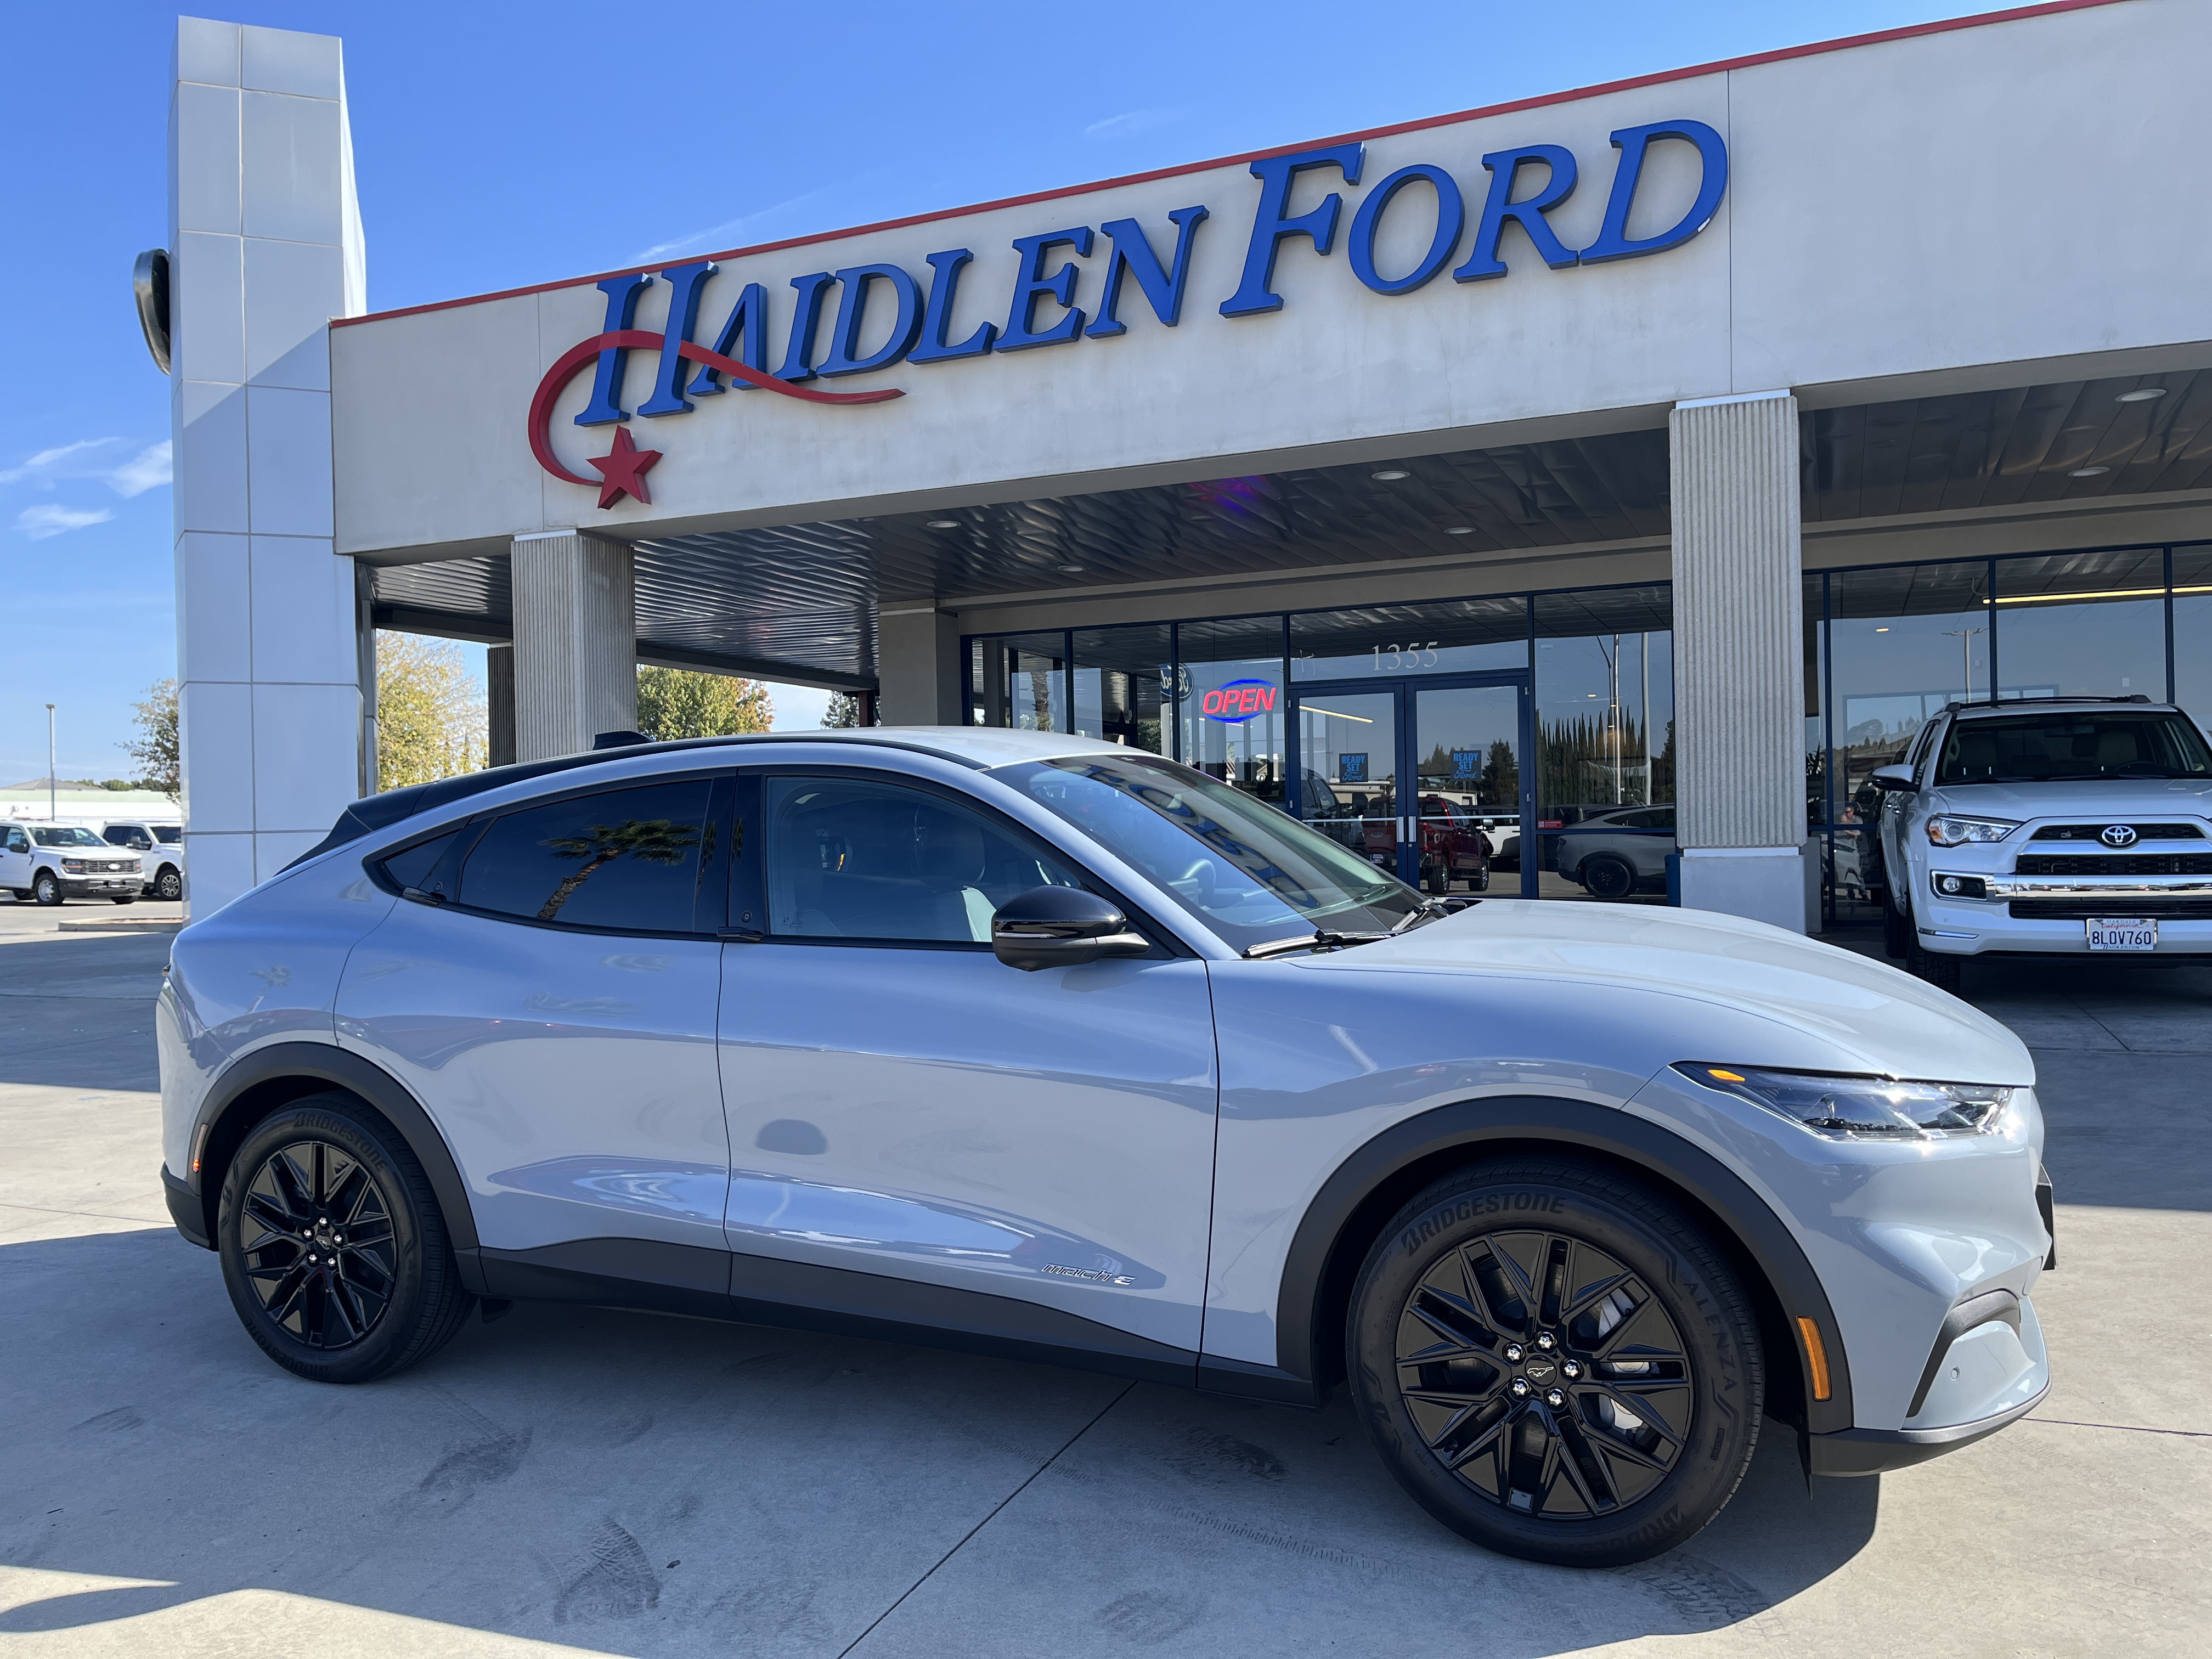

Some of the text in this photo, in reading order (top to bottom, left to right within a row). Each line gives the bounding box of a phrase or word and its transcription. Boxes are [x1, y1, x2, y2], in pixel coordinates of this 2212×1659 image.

[574, 119, 1728, 426] HAIDLEN FORD
[1372, 641, 1438, 671] 1355
[1203, 687, 1277, 714] OPEN
[1341, 755, 1365, 764] READY
[1453, 752, 1479, 761] READY
[1346, 764, 1360, 772] SET
[1458, 761, 1473, 770] SET
[1342, 771, 1364, 781] Ford
[1454, 769, 1477, 779] Ford
[2092, 931, 2151, 945] 8LOV760
[294, 1112, 388, 1172] BRIDGESTONE
[1401, 1191, 1568, 1257] BRIDGESTONE
[1683, 1282, 1738, 1392] ALENZA
